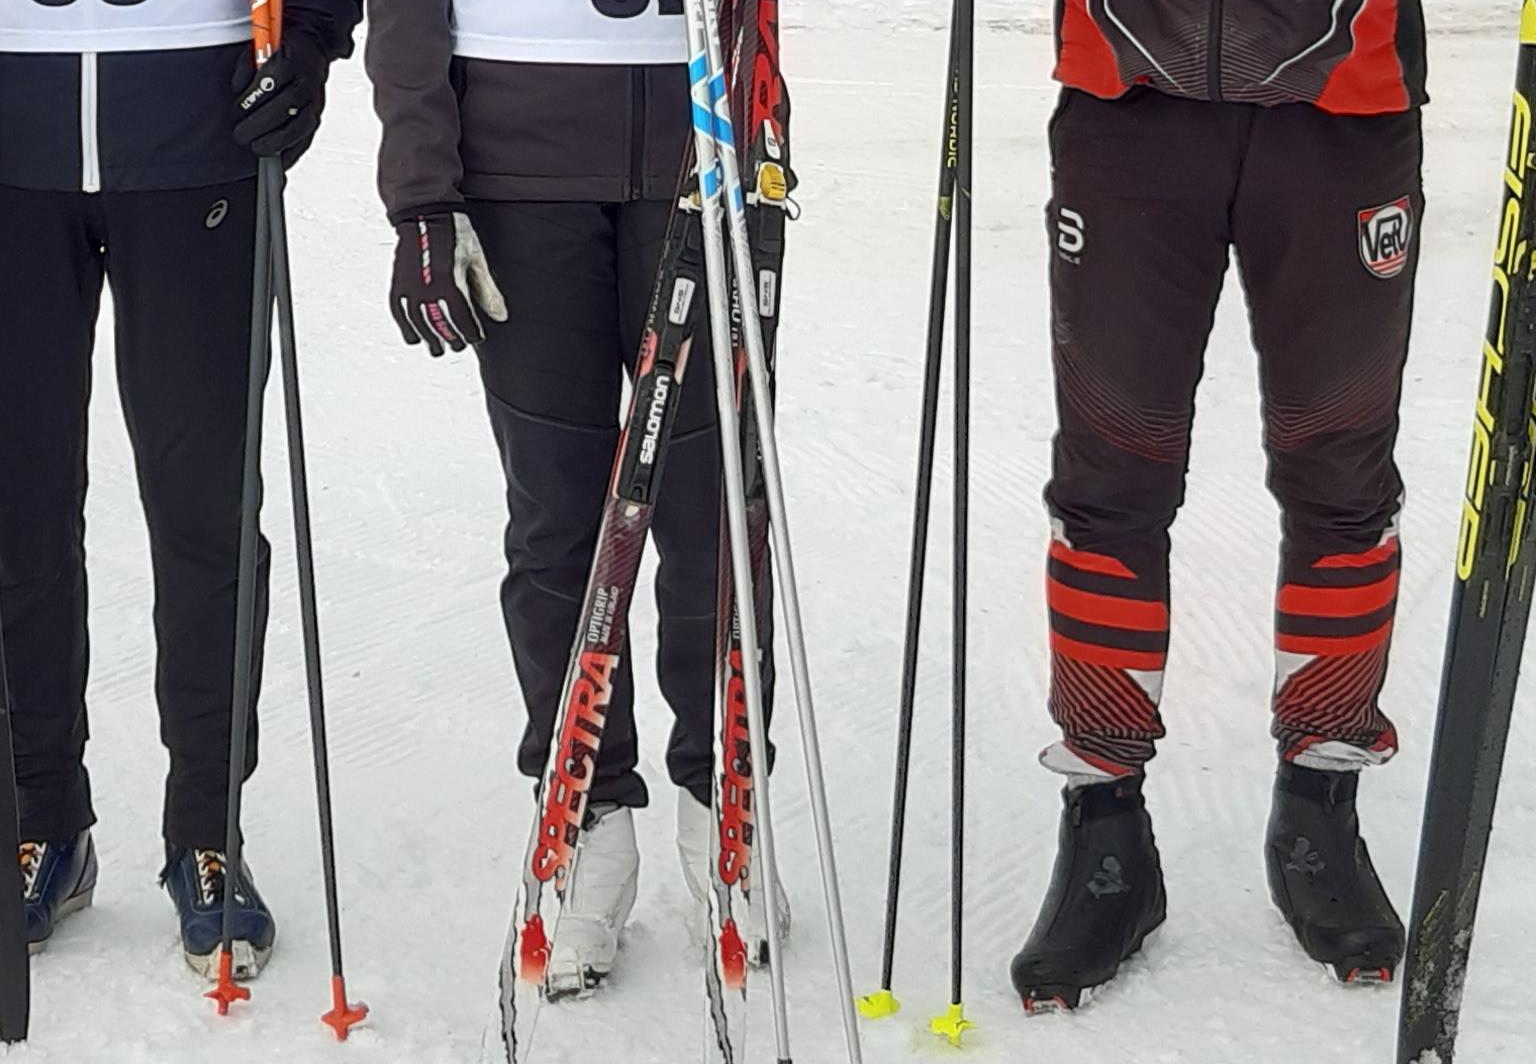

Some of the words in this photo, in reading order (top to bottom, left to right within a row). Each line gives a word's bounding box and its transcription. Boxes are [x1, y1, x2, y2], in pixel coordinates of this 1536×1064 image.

[640, 374, 671, 466] salomon
[587, 586, 610, 643] OPTIGRIP
[532, 651, 620, 892] SPECTRA
